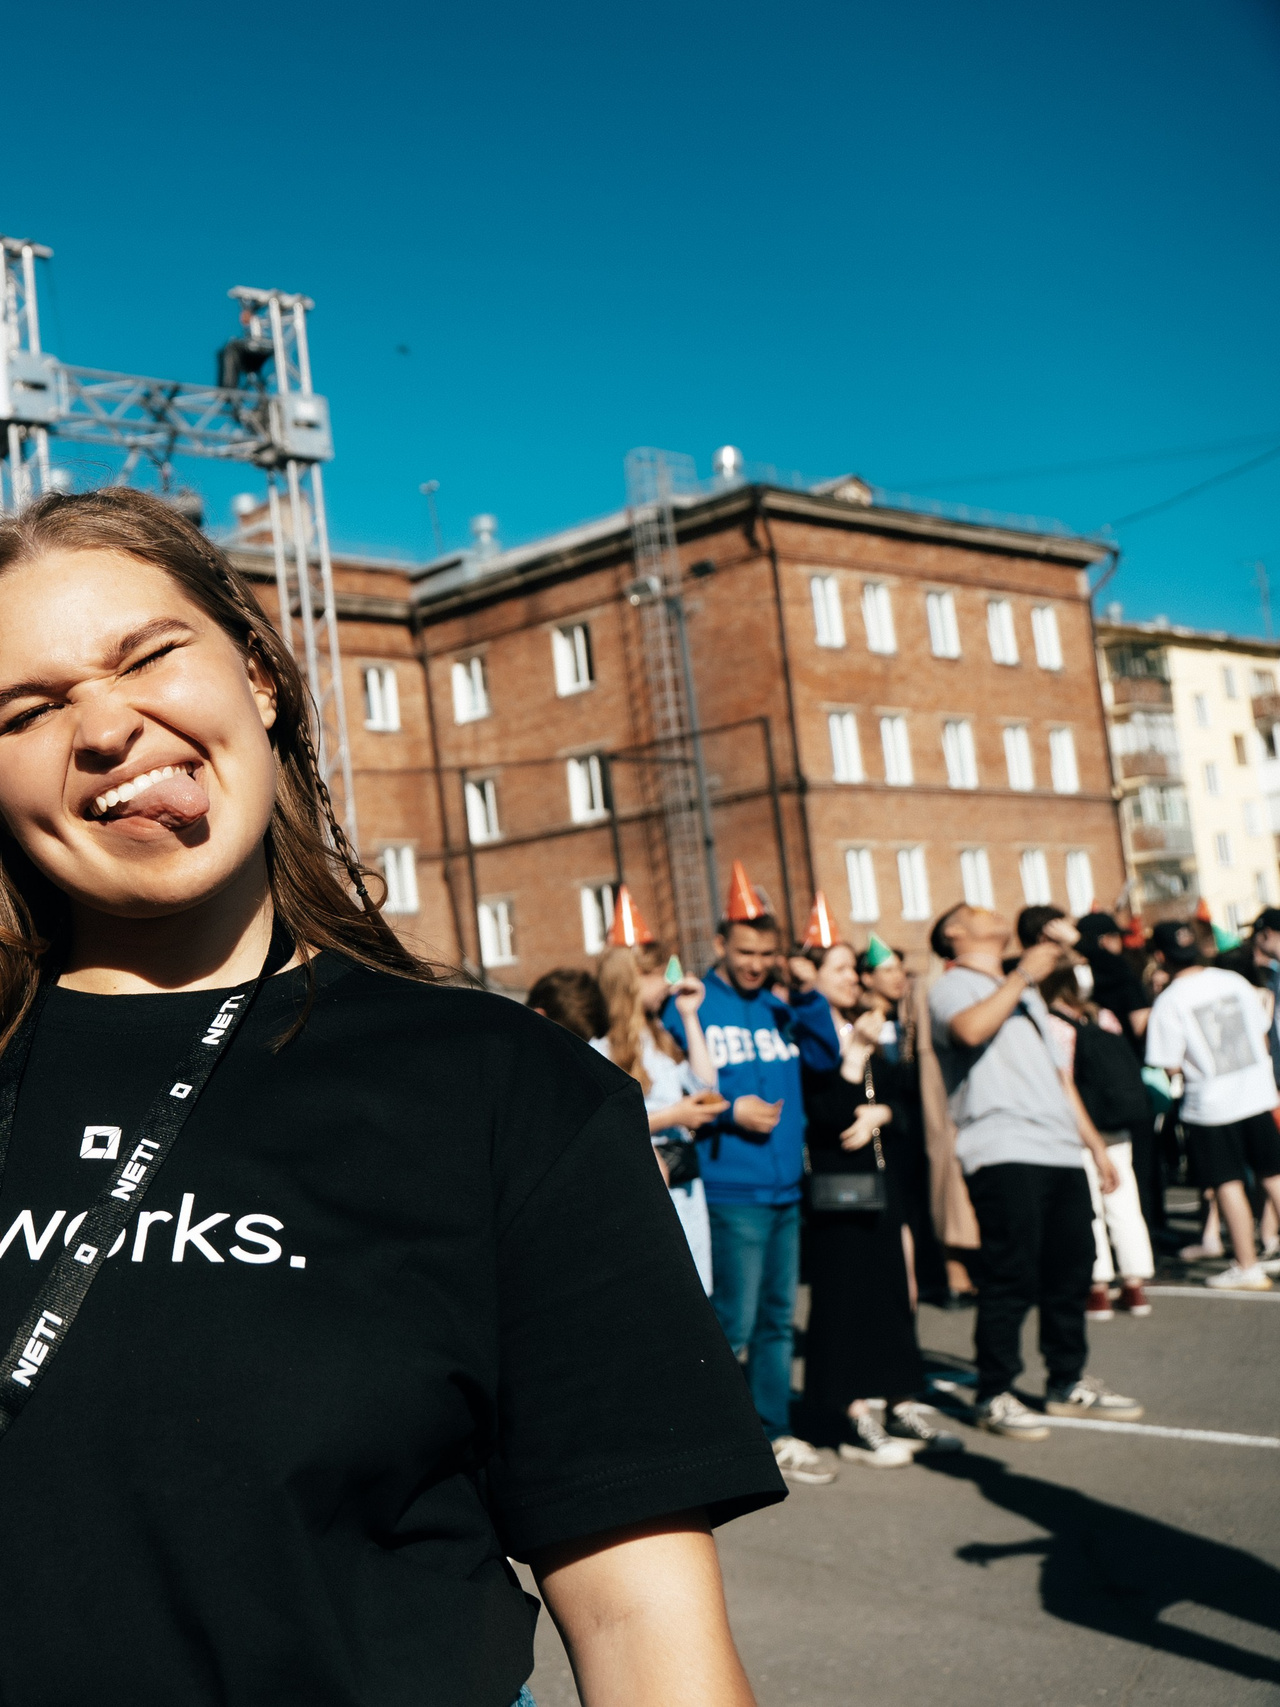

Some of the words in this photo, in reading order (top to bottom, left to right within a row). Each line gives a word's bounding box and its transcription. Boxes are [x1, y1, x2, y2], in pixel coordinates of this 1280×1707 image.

[202, 994, 245, 1045] NETI
[110, 1138, 160, 1200] NETI
[11, 1310, 63, 1387] NETI
